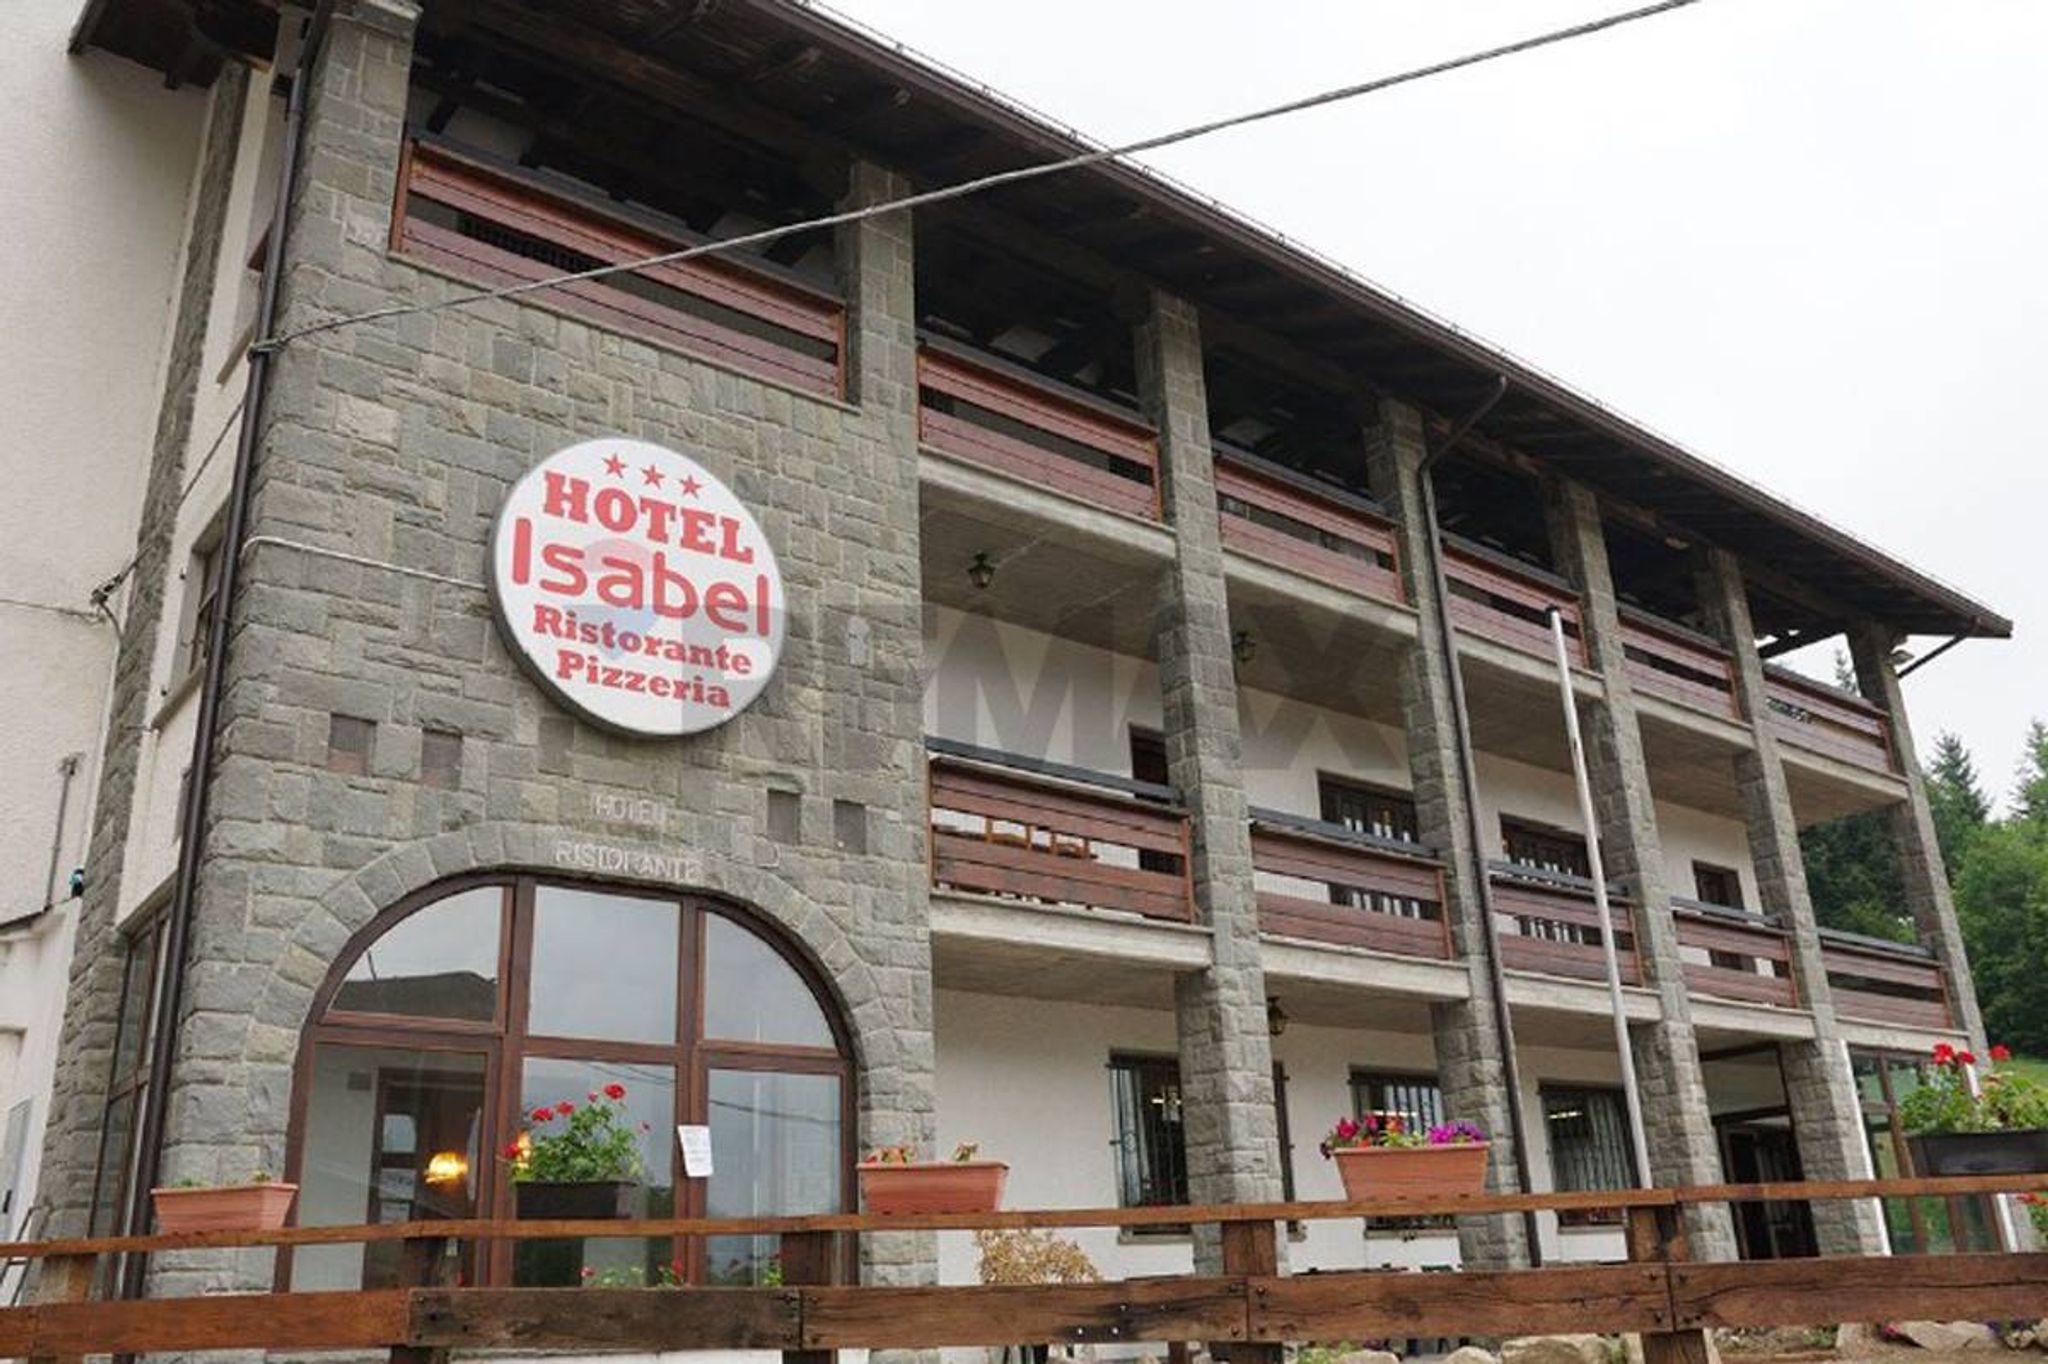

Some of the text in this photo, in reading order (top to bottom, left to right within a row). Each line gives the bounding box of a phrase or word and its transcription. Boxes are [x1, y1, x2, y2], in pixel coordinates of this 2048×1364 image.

[543, 471, 754, 564] HOTEL
[512, 517, 770, 637] Isabel
[533, 604, 752, 674] Ristorante
[556, 649, 730, 709] Pizzeria
